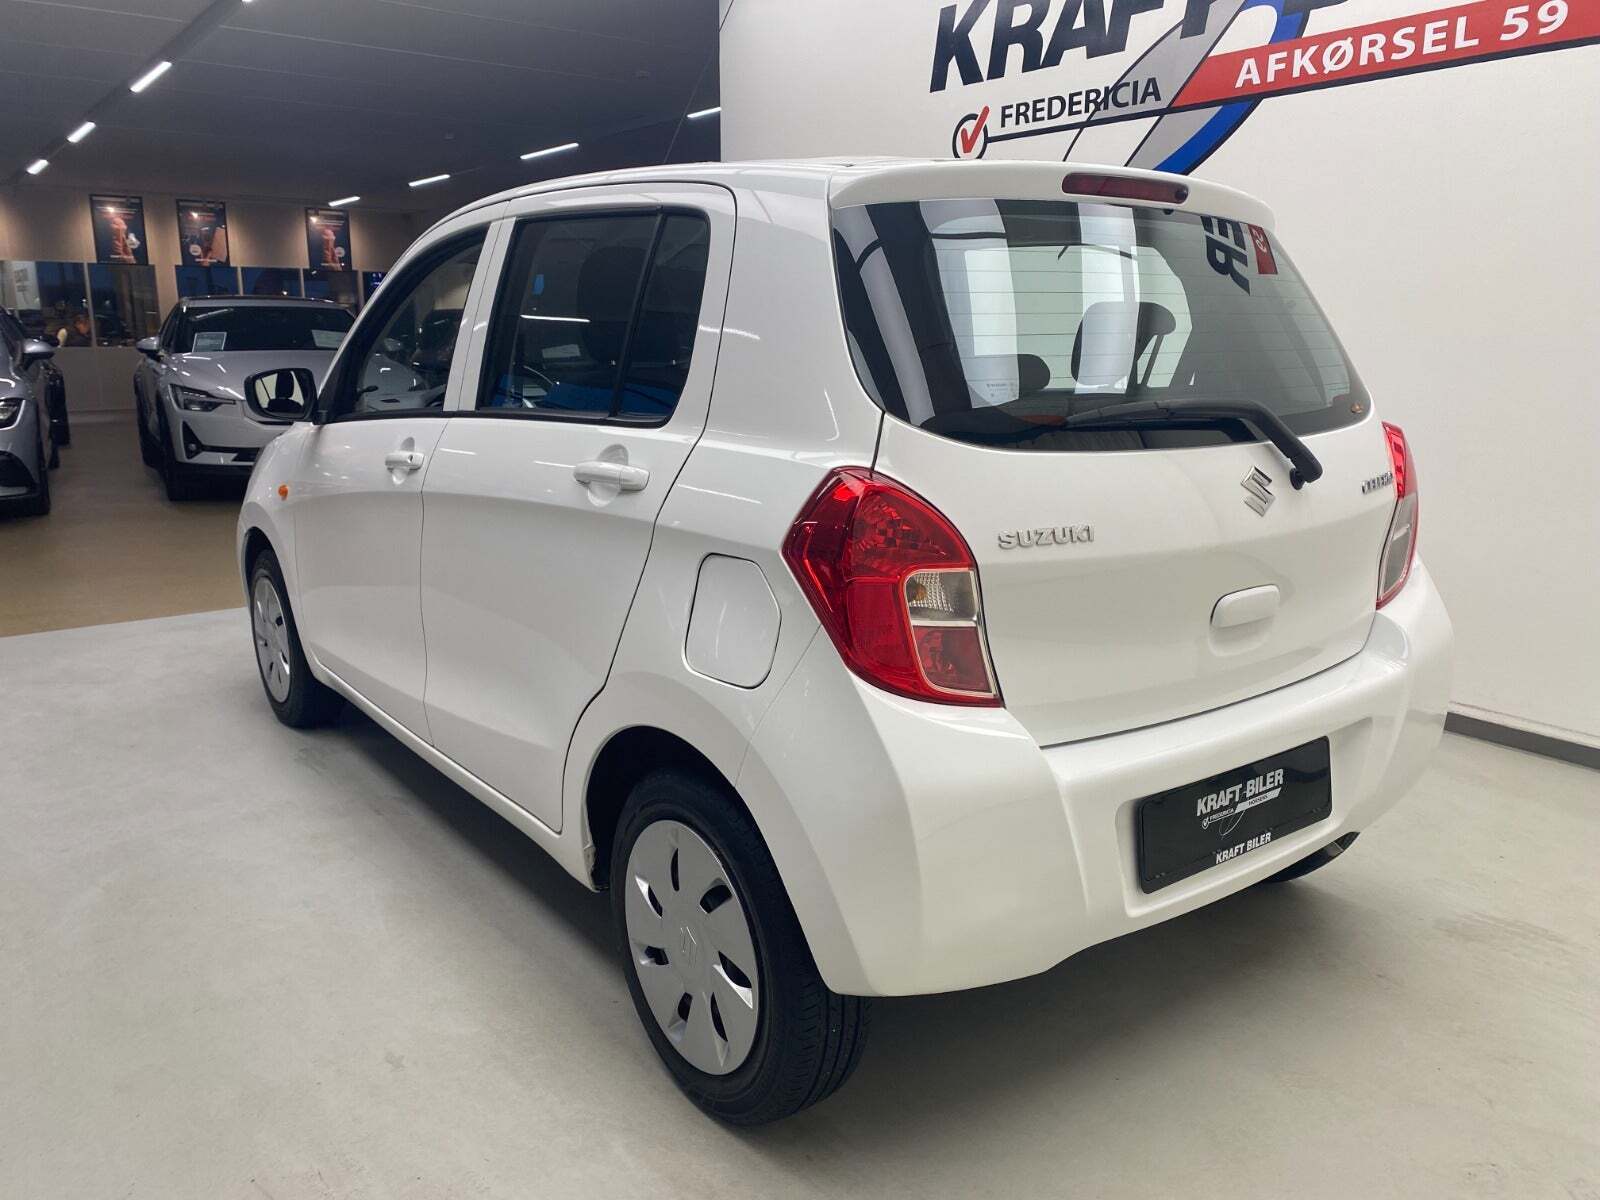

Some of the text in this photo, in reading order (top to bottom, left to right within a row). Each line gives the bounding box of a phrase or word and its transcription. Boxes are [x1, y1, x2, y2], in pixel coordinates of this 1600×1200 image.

[1235, 0, 1568, 88] AFKØRSEL 59
[1001, 77, 1162, 128] FREDERICIA
[998, 524, 1094, 549] SUZUKI
[1216, 832, 1272, 864] KRAFT BILER
